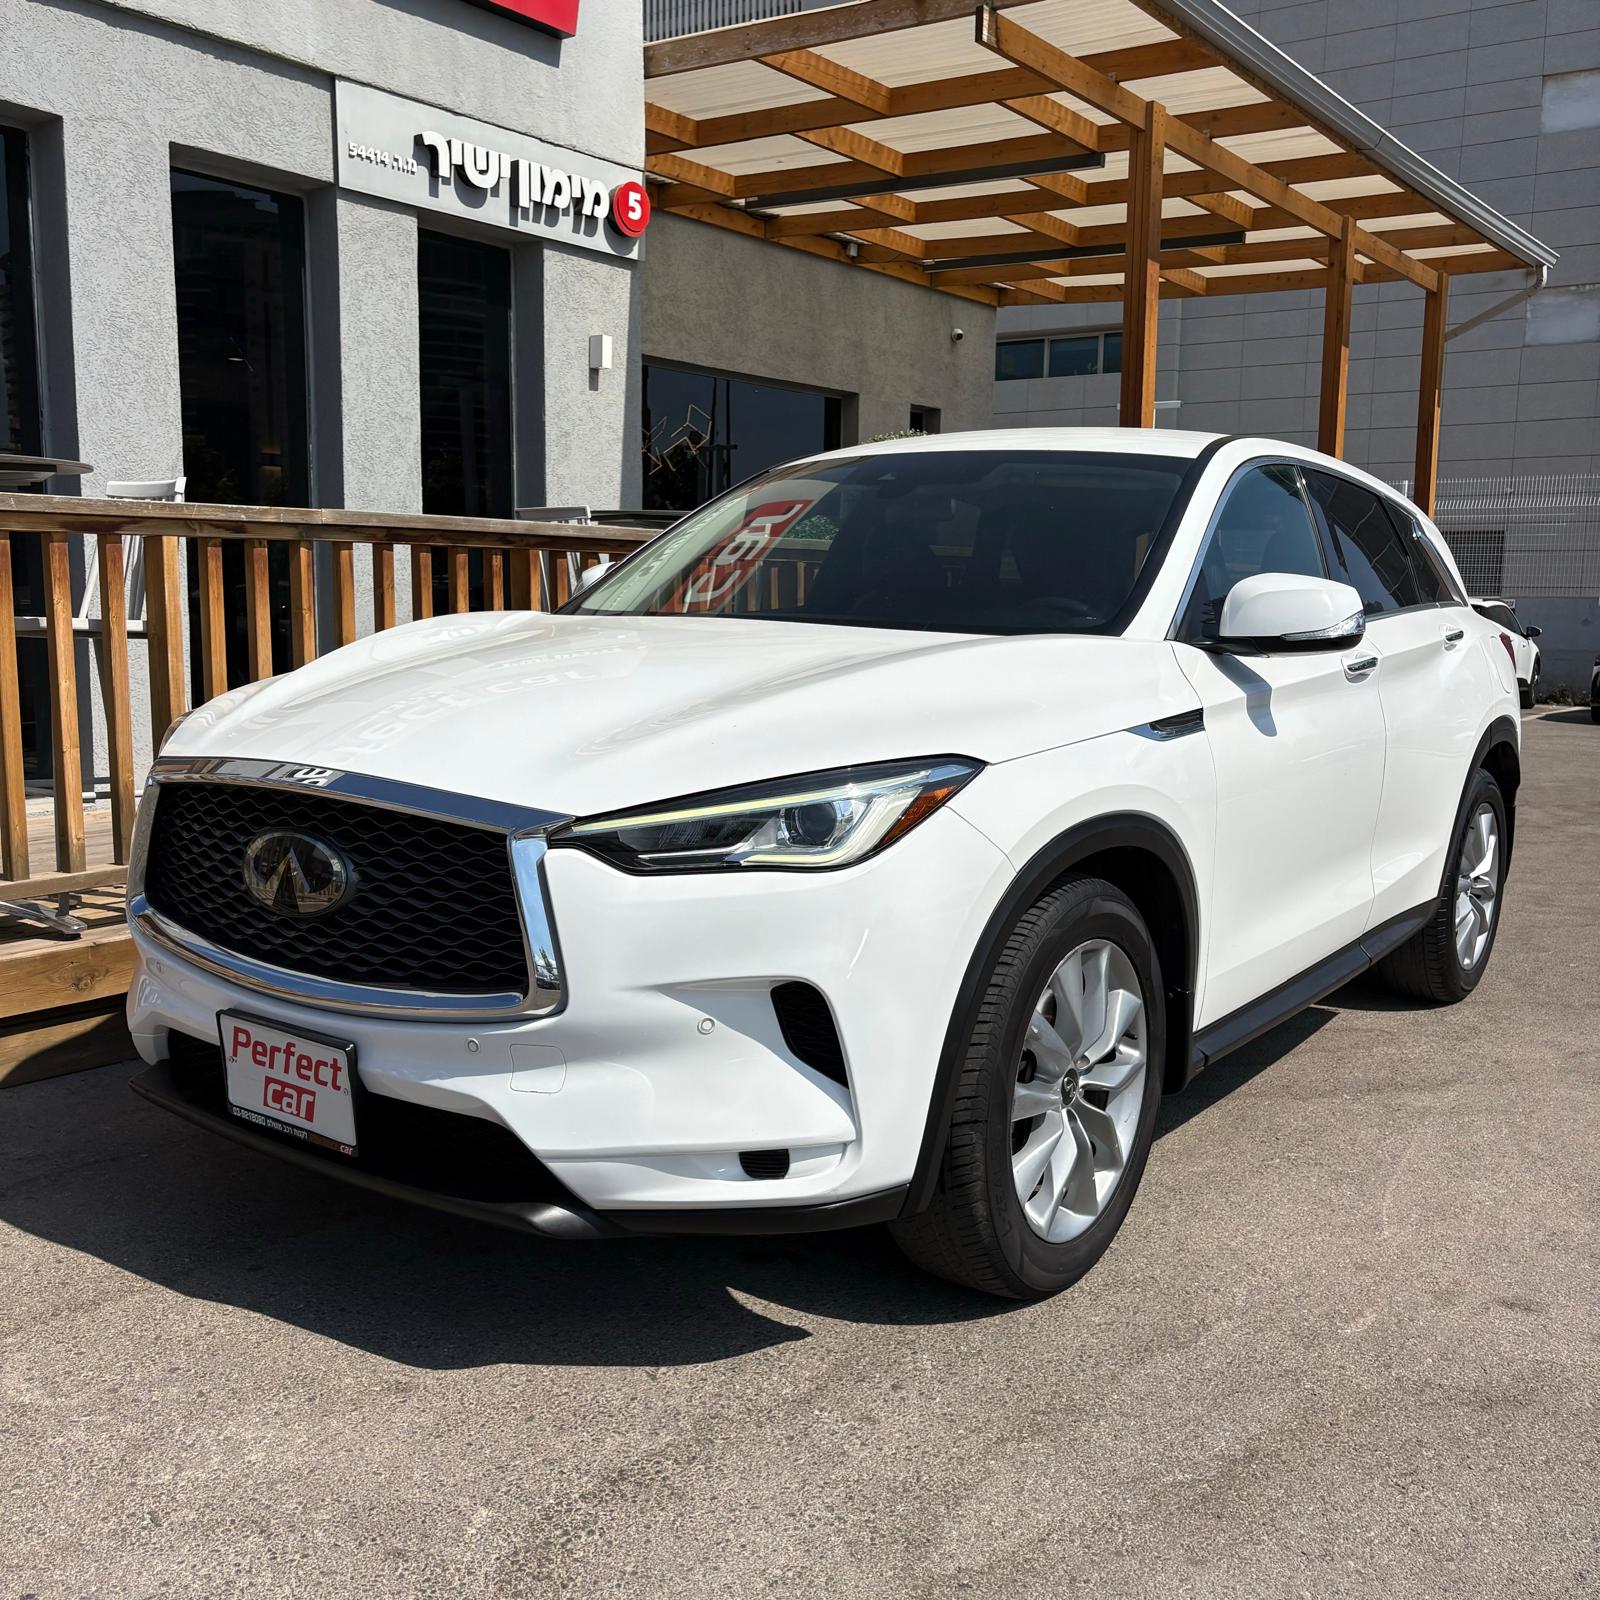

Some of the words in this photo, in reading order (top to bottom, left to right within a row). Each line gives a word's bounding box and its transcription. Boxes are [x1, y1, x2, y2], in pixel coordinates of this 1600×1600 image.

[348, 142, 390, 166] 54414
[417, 130, 511, 189] ישיר
[513, 158, 610, 219] מימון
[627, 191, 643, 221] 5
[232, 1025, 342, 1091] Perfect
[267, 1082, 314, 1119] car
[340, 1144, 353, 1155] car
